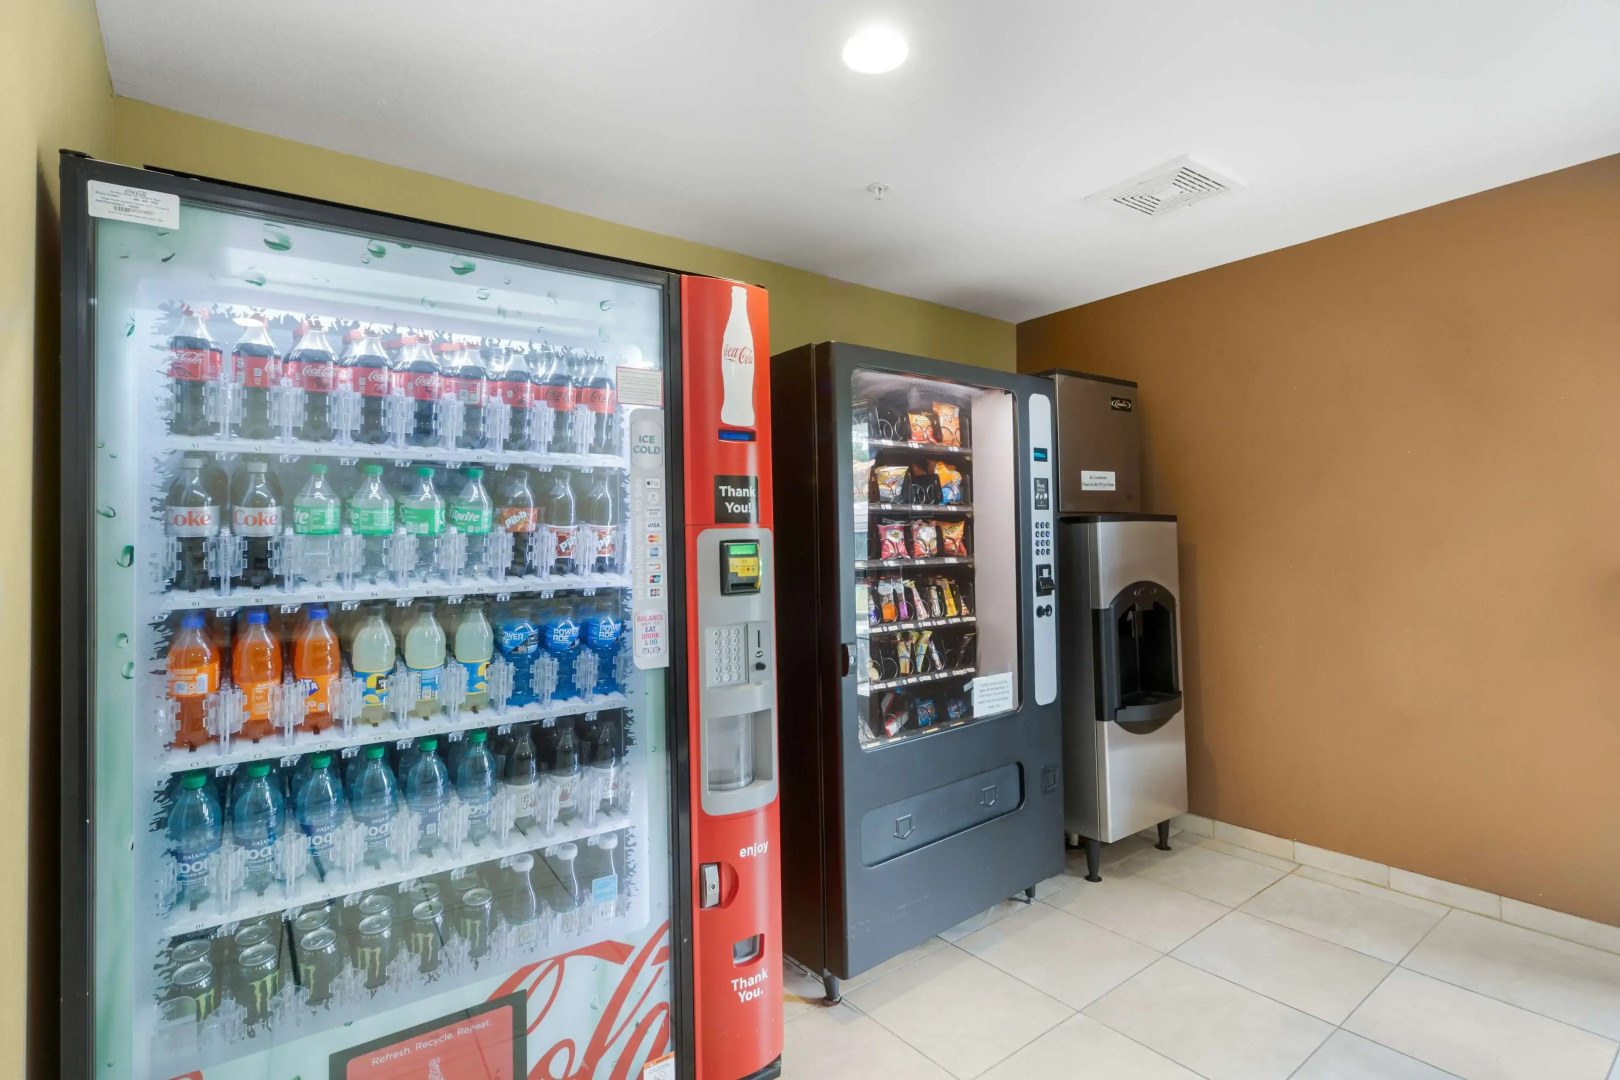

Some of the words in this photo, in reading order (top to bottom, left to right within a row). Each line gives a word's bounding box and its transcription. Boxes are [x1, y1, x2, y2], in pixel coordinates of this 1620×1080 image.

[638, 435, 655, 444] ICE
[633, 445, 661, 454] COLD
[719, 486, 756, 498] Thank
[725, 502, 752, 513] You!
[166, 508, 212, 526] Coke
[234, 509, 278, 526] Coke
[739, 841, 768, 858] enjoy
[731, 968, 768, 992] Thank
[738, 989, 764, 1003] You.
[372, 1046, 412, 1066] Refresh.
[416, 1032, 454, 1052] Recycle.
[457, 1020, 492, 1037] Repeat.
